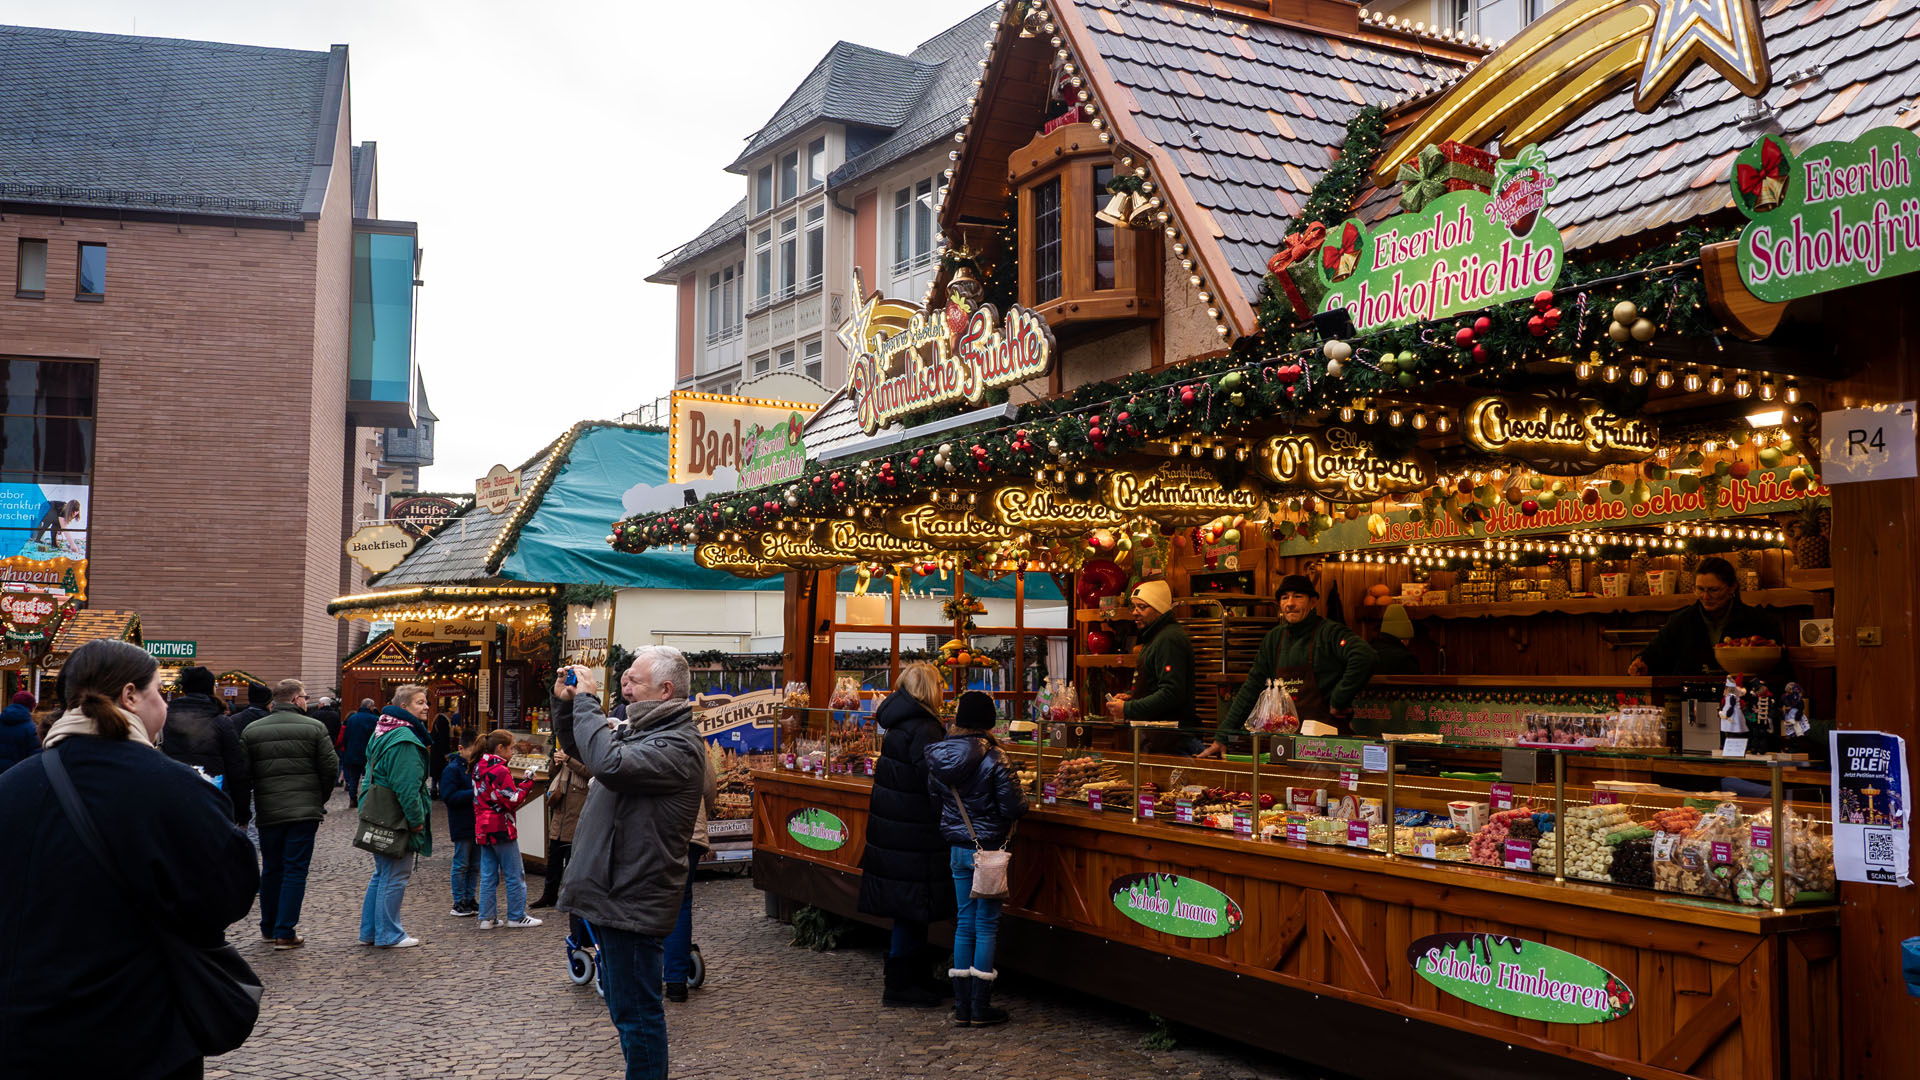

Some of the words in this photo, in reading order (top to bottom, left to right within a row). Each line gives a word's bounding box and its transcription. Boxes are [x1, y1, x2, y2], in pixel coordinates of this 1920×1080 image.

[1502, 168, 1533, 191] Eiserloh
[1804, 143, 1911, 203] Eiserloh
[1484, 173, 1555, 225] Himmlische
[1501, 194, 1545, 229] Früchte
[1372, 204, 1473, 271] Eiserloh
[1751, 200, 1920, 283] Schokofrü
[1326, 239, 1555, 329] Schokofrüchte
[854, 340, 957, 429] Himmlische
[960, 311, 1042, 397] Früchte
[1326, 427, 1374, 452] Edles
[1472, 395, 1585, 452] Chocolate
[1585, 408, 1657, 453] Fruits
[689, 411, 750, 475] Back
[757, 429, 787, 459] Eiserloh
[1848, 427, 1886, 456] R4
[739, 452, 804, 491] Schokofrüchte
[1159, 461, 1213, 481] Frankfurter
[1270, 433, 1425, 491] Marzipan
[0, 489, 24, 499] abor
[410, 505, 448, 515] Heiße
[995, 487, 1123, 525] Erdbeeren
[902, 505, 1012, 539] Trauben
[1484, 497, 1625, 532] Himmlische
[353, 540, 408, 552] Backfisch
[0, 565, 60, 584] ühwein
[444, 624, 487, 639] Backfisch
[566, 638, 608, 651] HAMBURGER
[146, 642, 194, 656] UCHTWEG
[1467, 706, 1490, 723] auch
[1492, 713, 1513, 724] zum
[1297, 743, 1333, 759] Himmlische
[1334, 745, 1361, 760] Früchte
[708, 822, 748, 833] itfrankfurt
[1870, 872, 1886, 880] SCAN
[1128, 887, 1170, 915] Schoko
[1172, 896, 1218, 924] Ananas
[1426, 948, 1492, 984] Schoko
[1497, 962, 1609, 1011] Himbeeren
